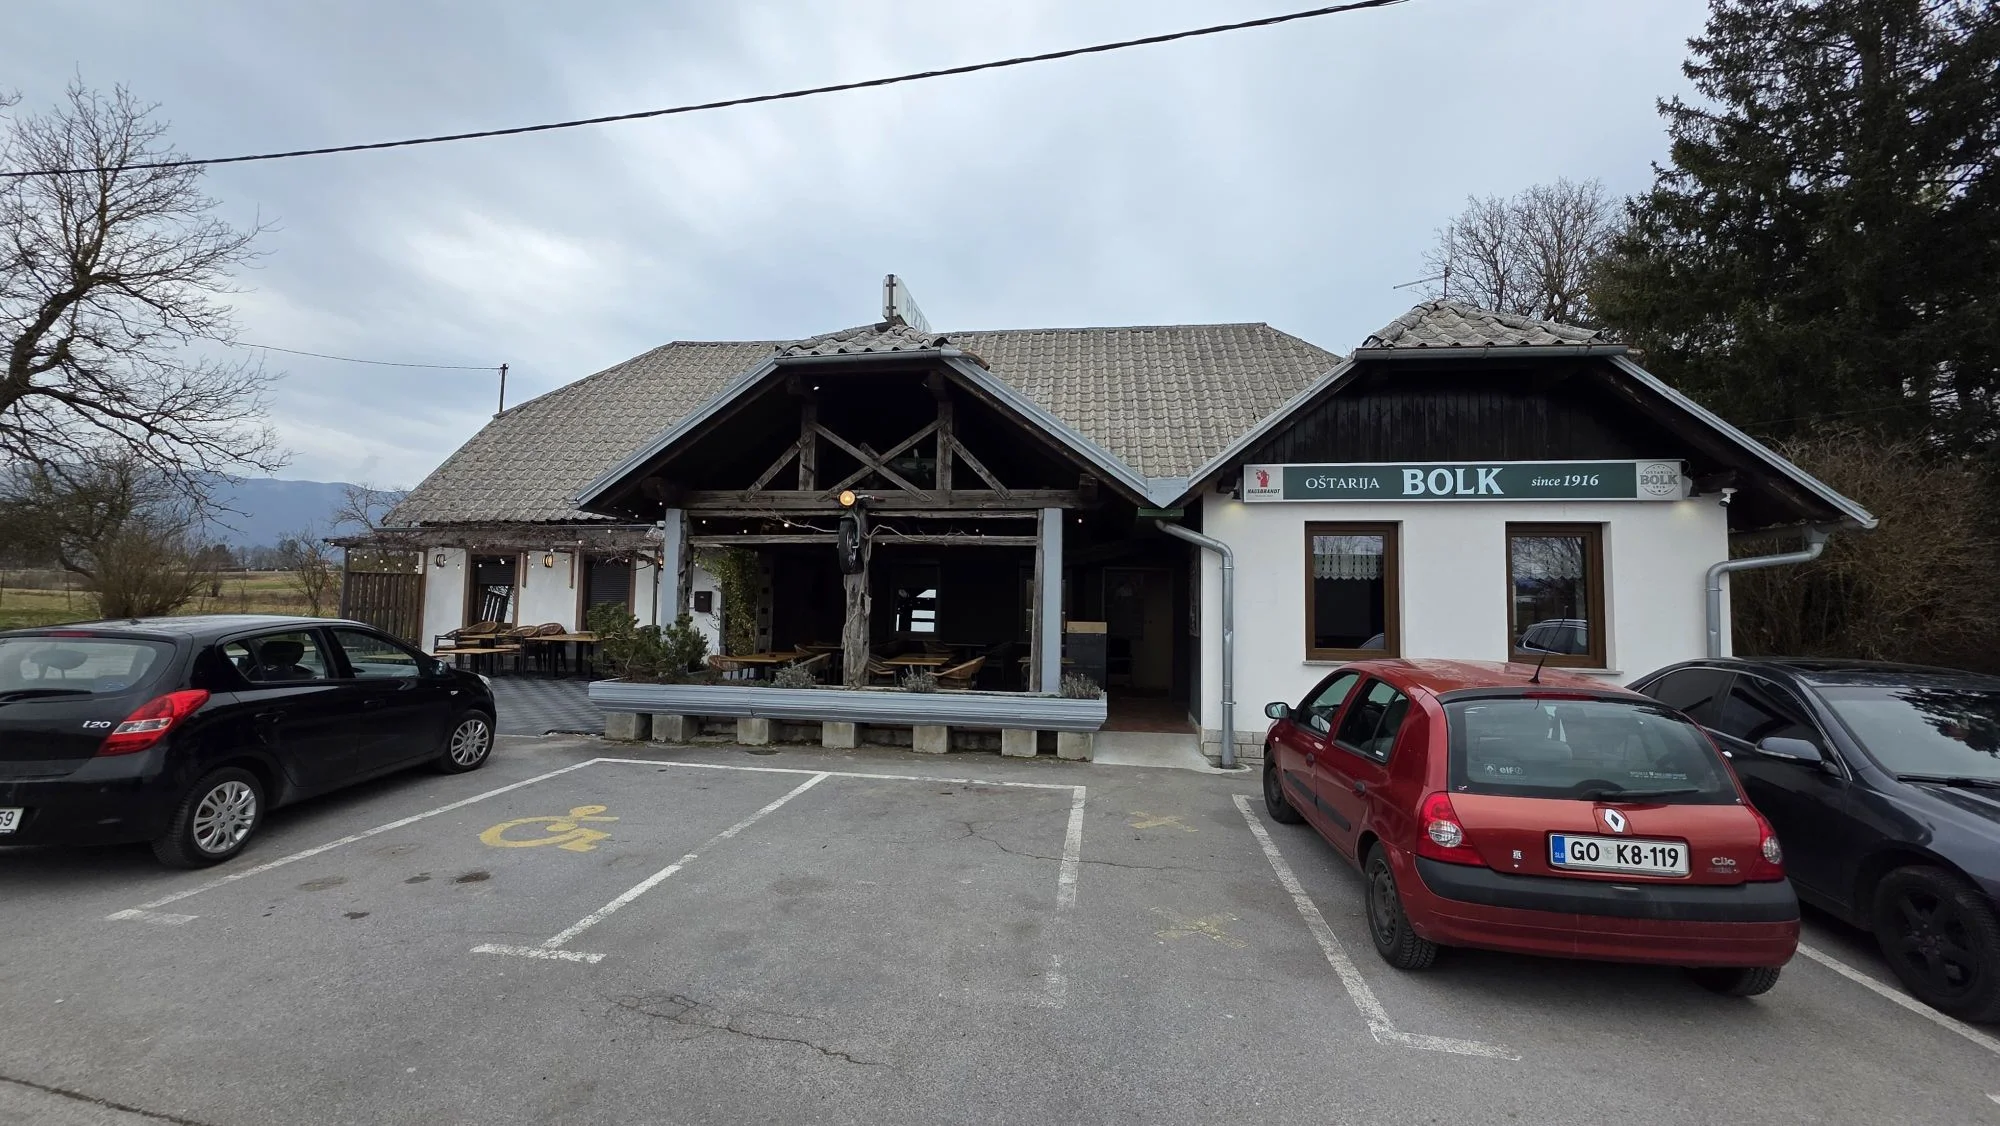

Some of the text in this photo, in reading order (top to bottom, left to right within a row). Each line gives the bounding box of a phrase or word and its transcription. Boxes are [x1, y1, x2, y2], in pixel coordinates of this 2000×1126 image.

[1305, 467, 1600, 496] OŠTARIJA BOLK since 1916
[1640, 474, 1678, 485] BOLK
[82, 720, 112, 729] i20
[1570, 841, 1679, 868] GO K8-119
[1711, 856, 1737, 866] Clio
